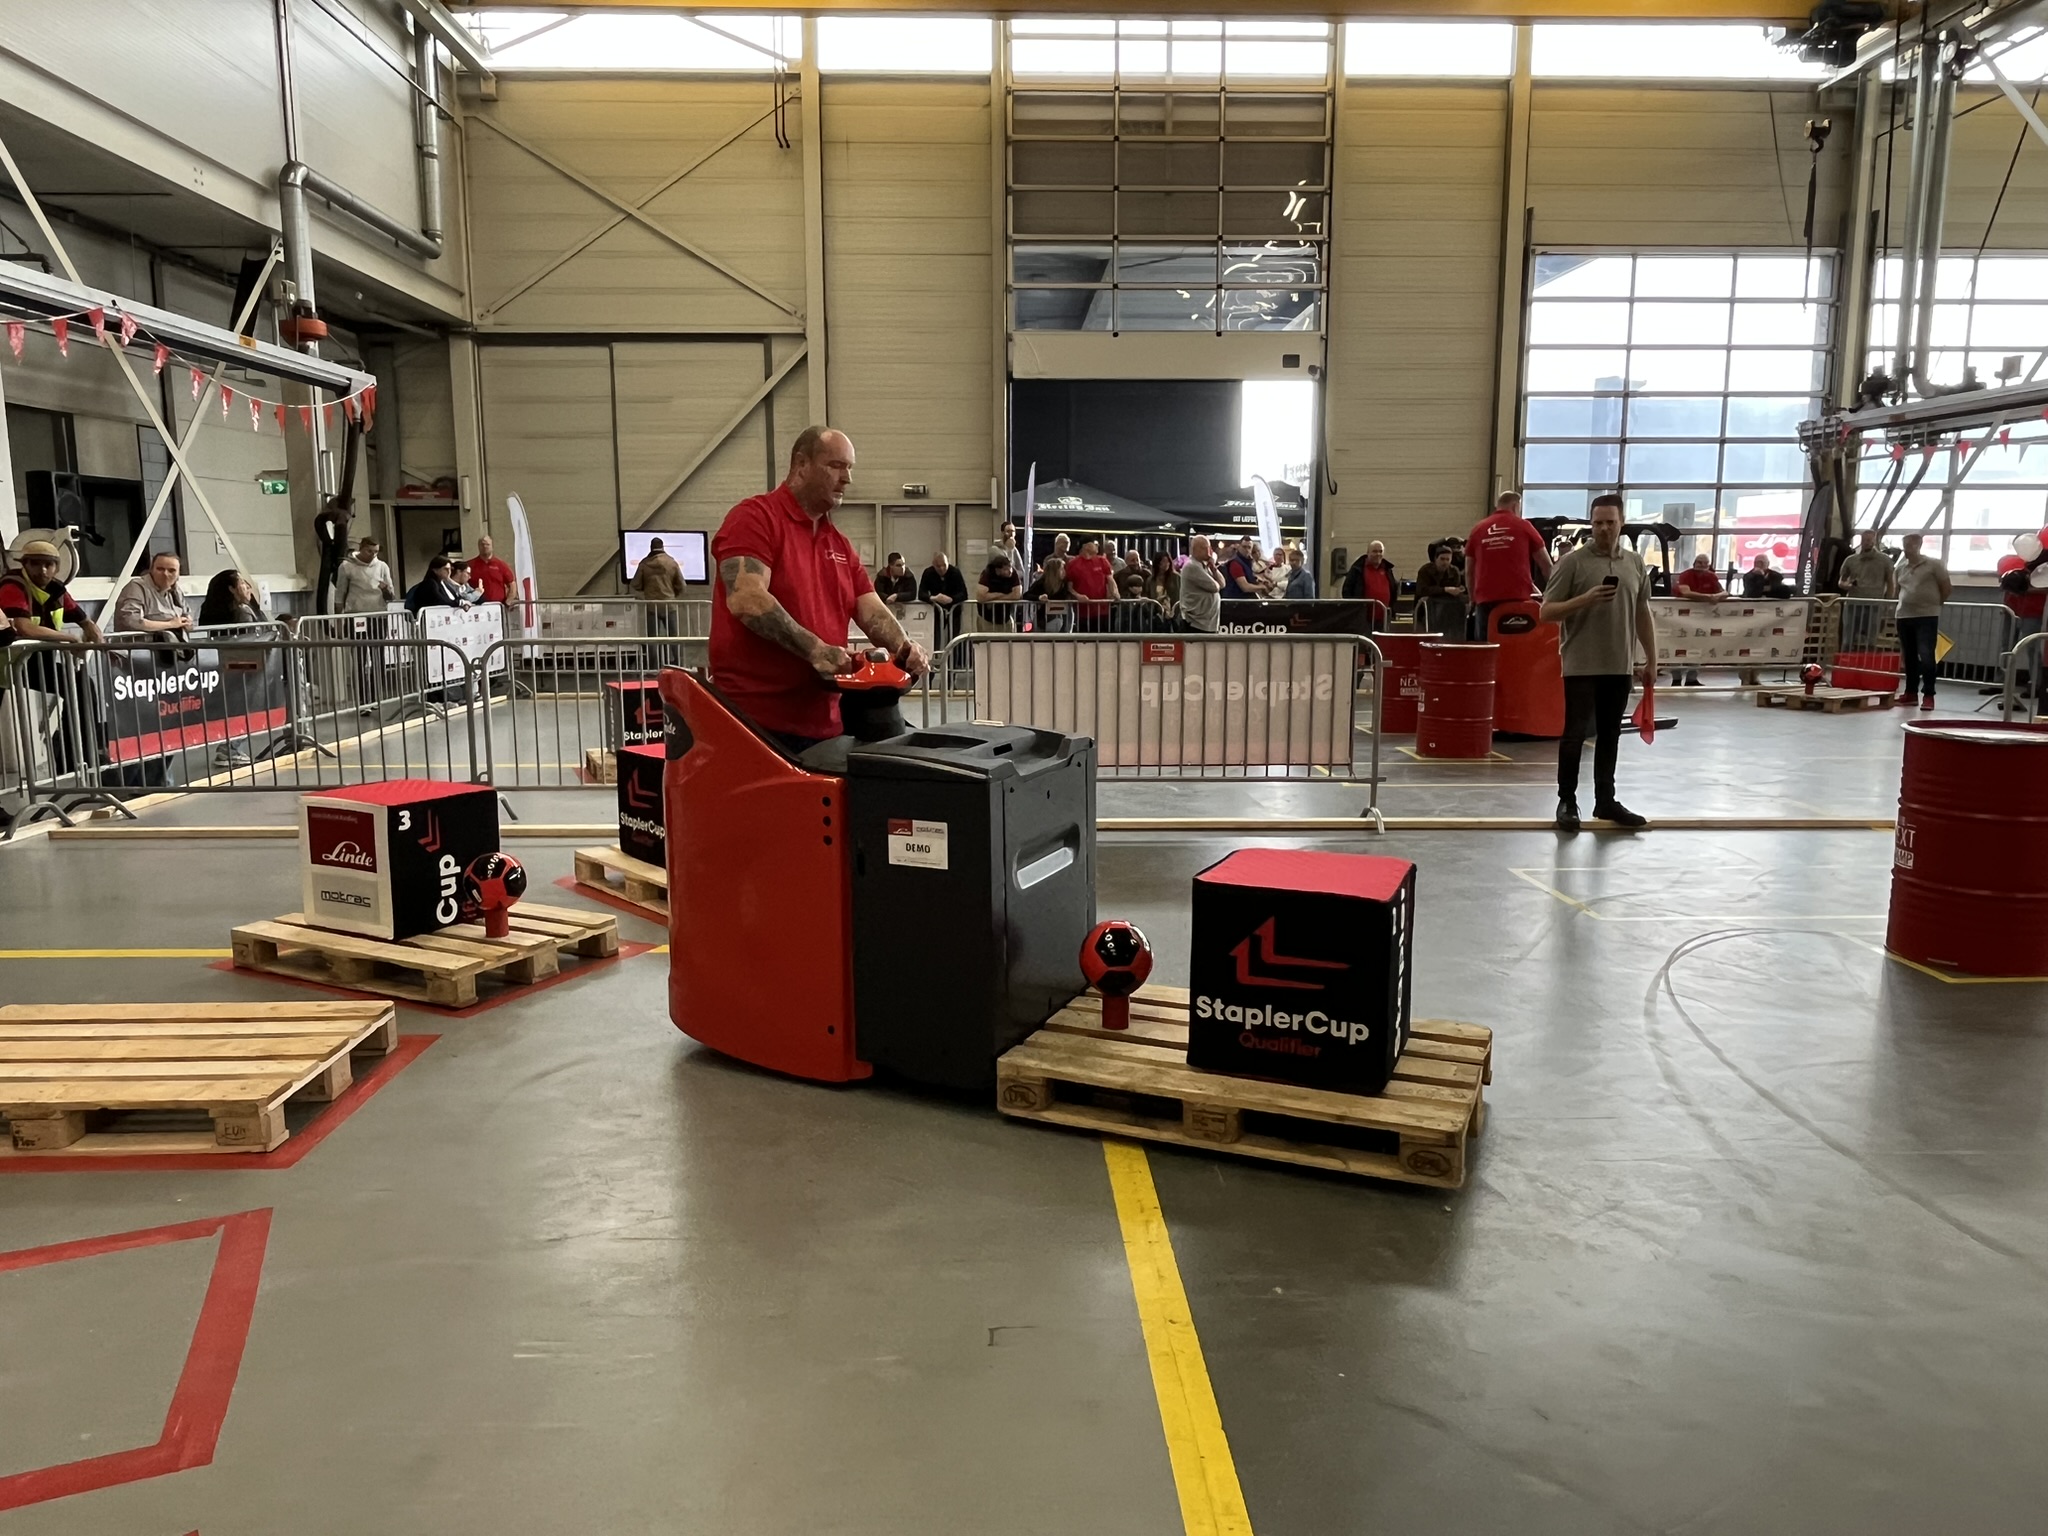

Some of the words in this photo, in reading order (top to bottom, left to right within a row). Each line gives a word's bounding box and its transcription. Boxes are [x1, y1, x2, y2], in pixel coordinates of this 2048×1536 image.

[114, 667, 219, 702] StaplerCup
[398, 810, 411, 831] 3
[620, 811, 666, 839] StaplerCup
[322, 841, 373, 867] Linde
[906, 843, 931, 853] DEMO
[321, 890, 371, 907] motrac
[1196, 995, 1370, 1045] StaplerCup
[1239, 1032, 1322, 1058] Qualifier
